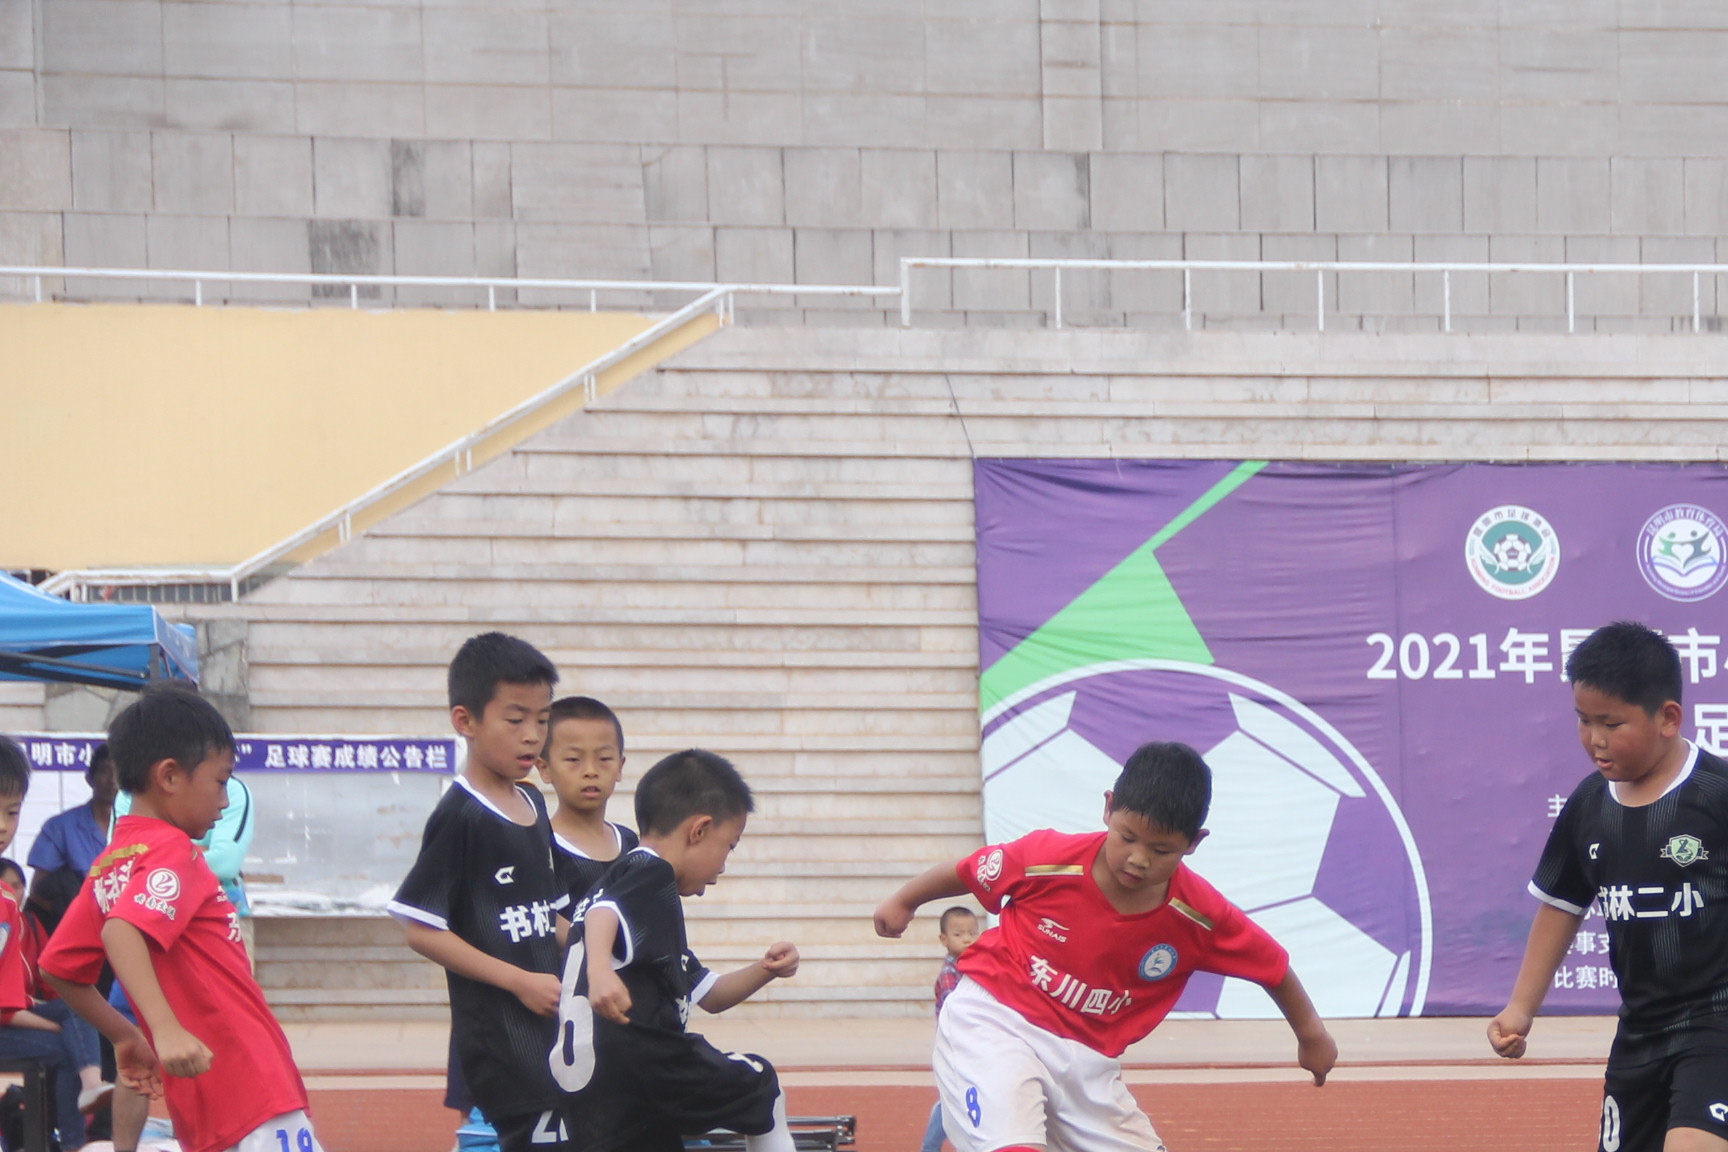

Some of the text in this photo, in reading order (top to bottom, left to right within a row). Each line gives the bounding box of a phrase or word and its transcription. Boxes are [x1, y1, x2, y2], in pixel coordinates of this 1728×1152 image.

[19, 742, 449, 768] 明市小 ”足球赛成绩公告栏
[1037, 923, 1068, 943] SUNAIS
[1029, 954, 1133, 1016] 东川四小
[965, 1086, 981, 1128] 8
